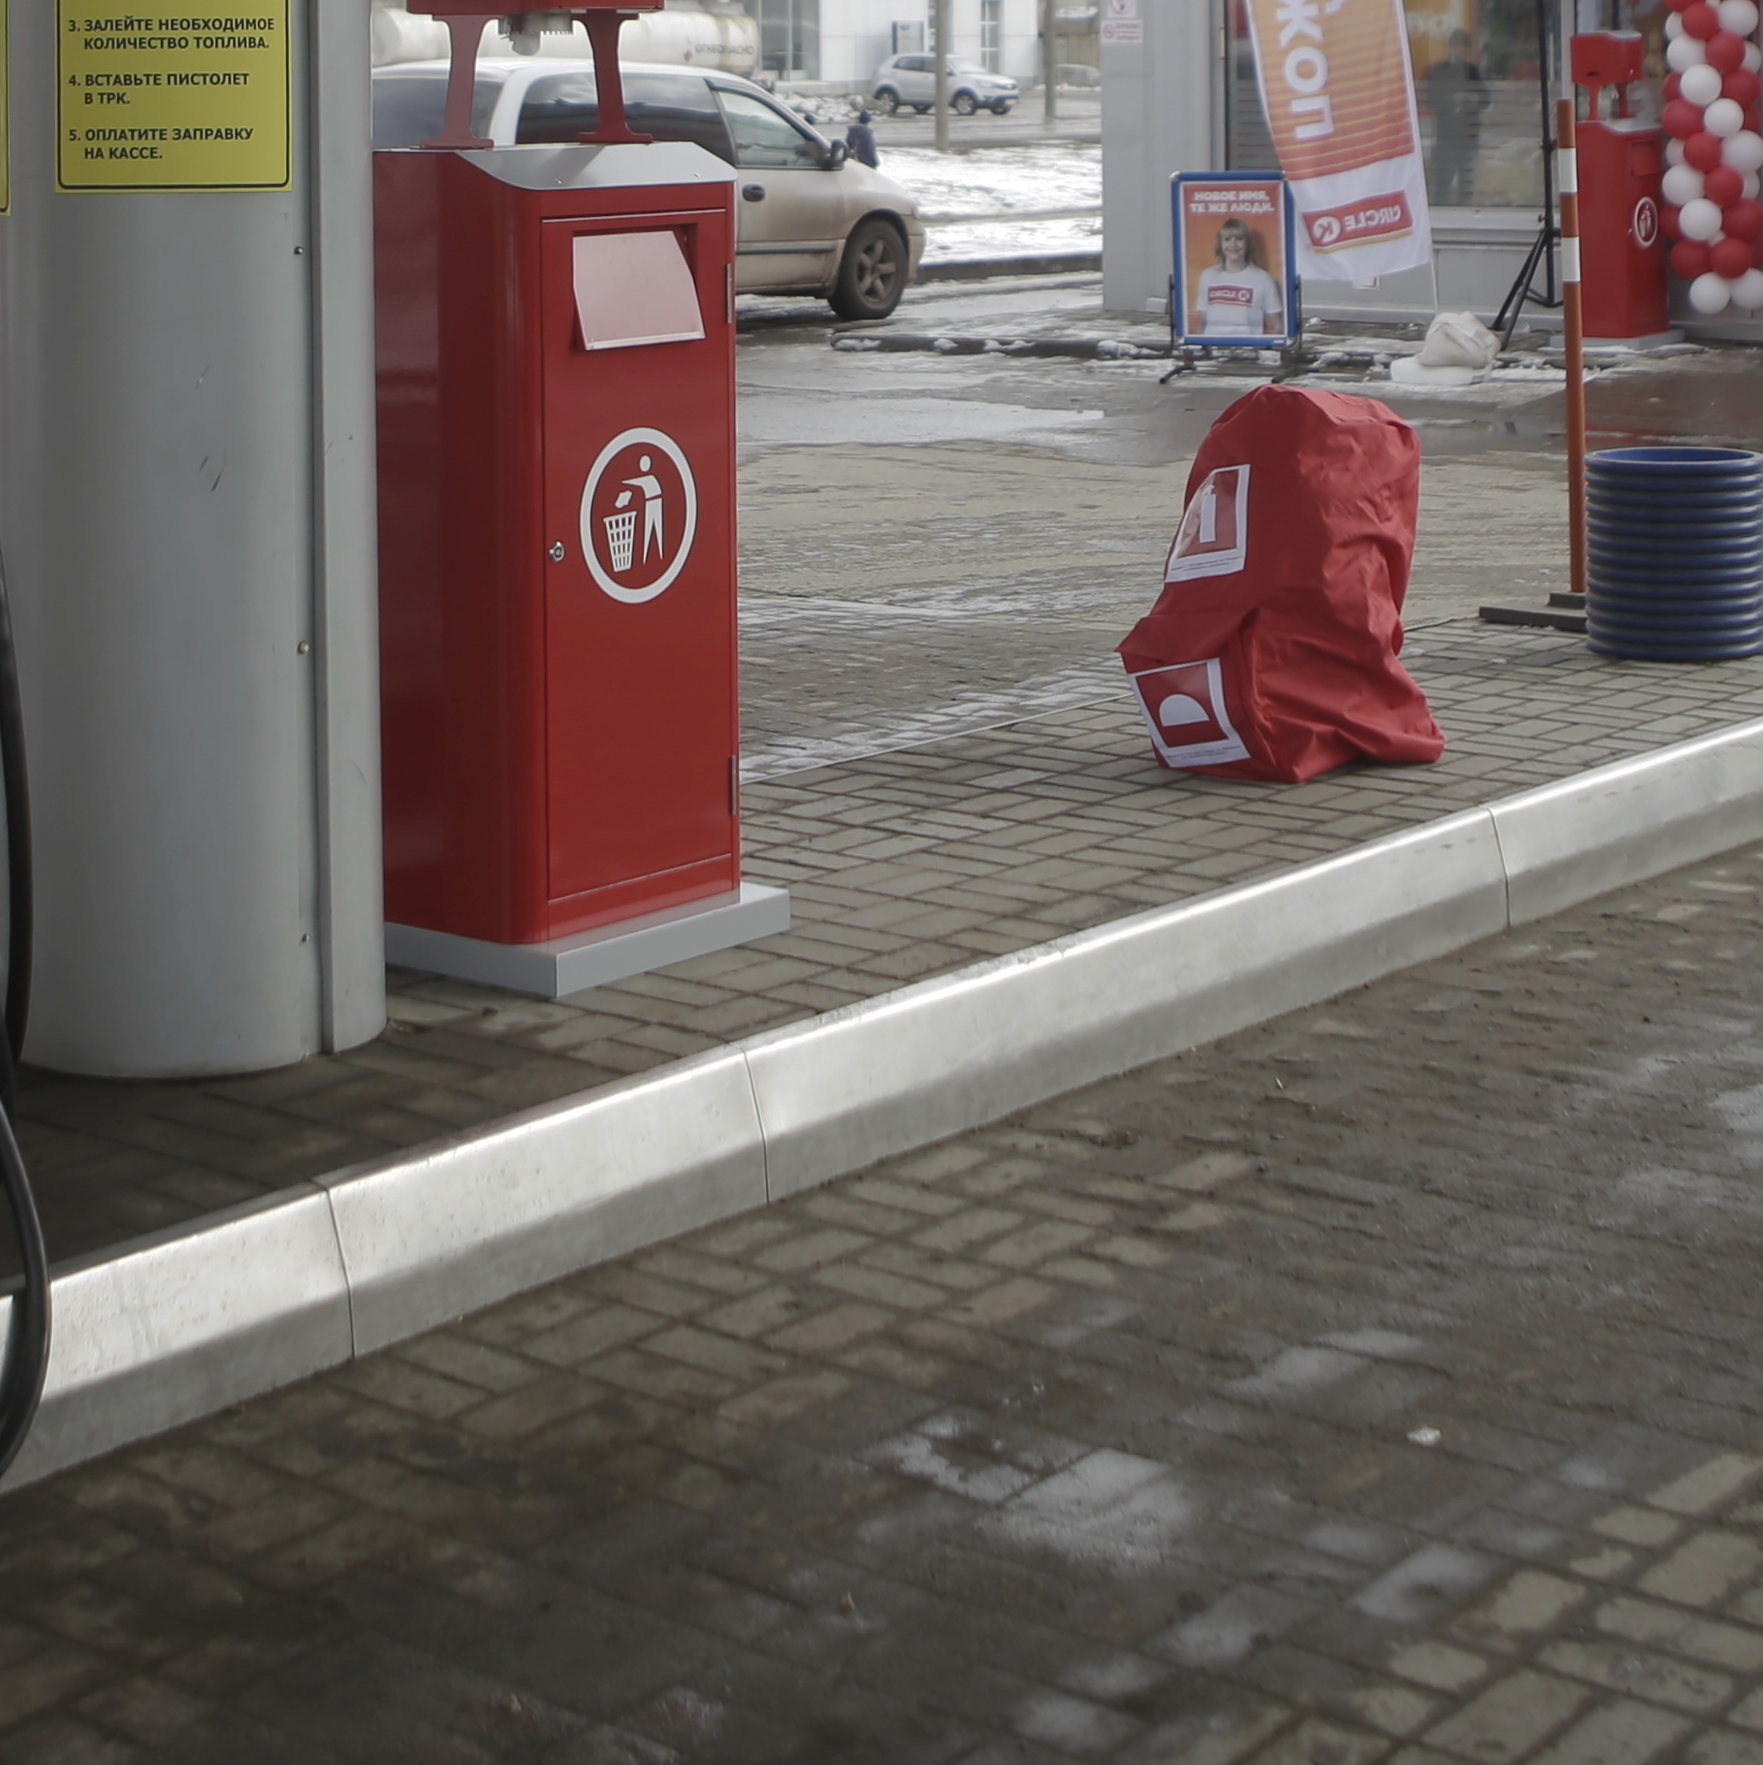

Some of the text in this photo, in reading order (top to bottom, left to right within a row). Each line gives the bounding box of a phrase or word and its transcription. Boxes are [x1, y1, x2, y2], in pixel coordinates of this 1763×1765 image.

[68, 15, 275, 32] 3. ЗАЛЕЙТЕ НЕОБХОДИМОЕ
[84, 37, 270, 50] КОЛИЧЕСТВО ТОПЛИВА.
[68, 73, 249, 86] 4. ВСТАВЬТЕ ПИСТОЛЕТ
[85, 92, 130, 104] В ТРК.
[69, 128, 254, 141] 5. ОПЛАТИТЕ ЗАПРАВКУ
[85, 147, 163, 159] НА КАССЕ.
[1194, 190, 1235, 201] НОВОЕ
[1190, 202, 1207, 213] ТЕ
[1210, 202, 1228, 213] ЖЕ
